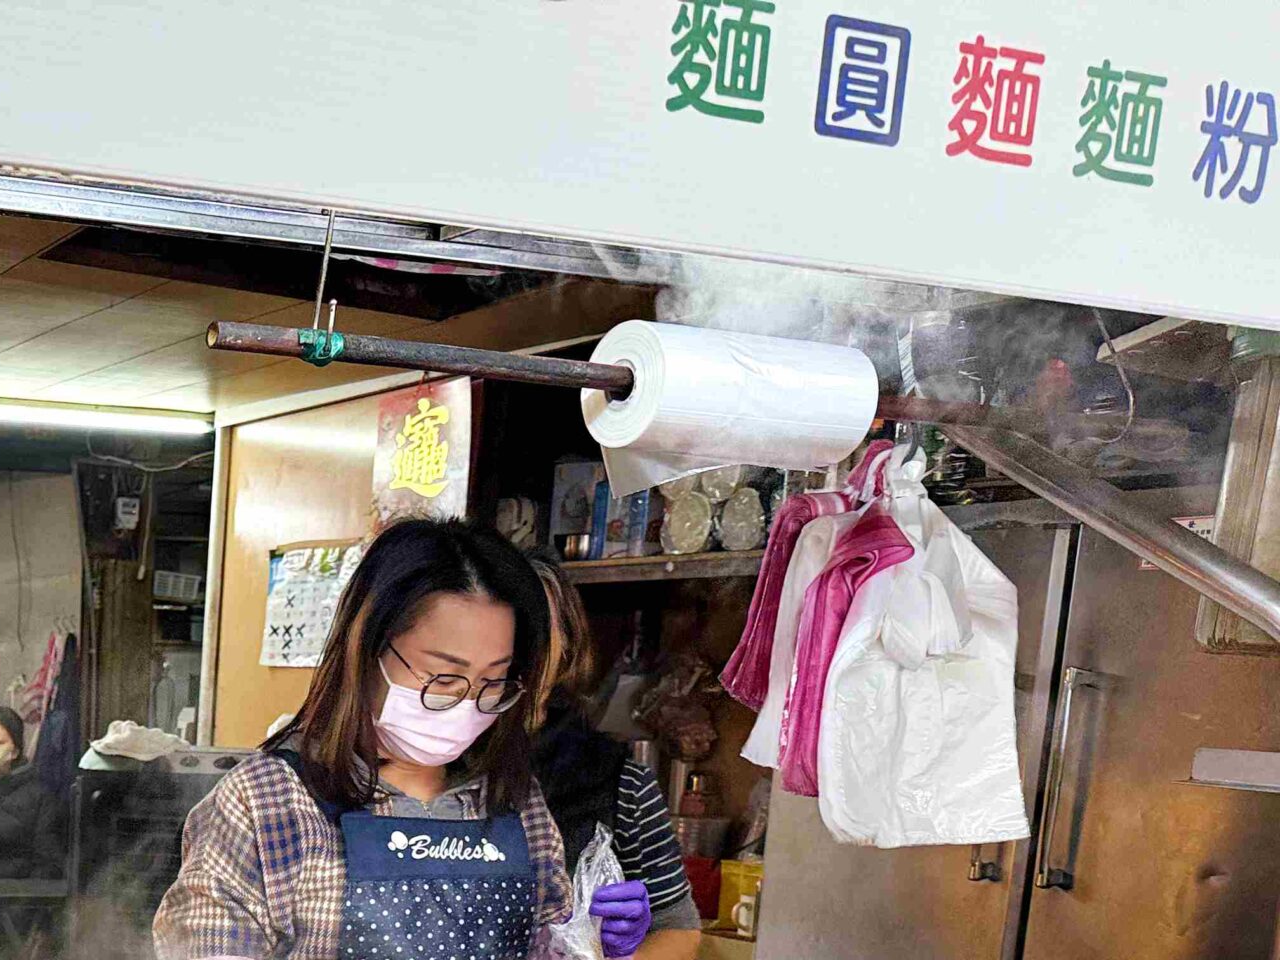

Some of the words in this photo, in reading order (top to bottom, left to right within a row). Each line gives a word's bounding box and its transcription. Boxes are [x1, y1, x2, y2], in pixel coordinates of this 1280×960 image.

[665, 0, 776, 124] 麵
[814, 13, 912, 147] 圓
[945, 34, 1046, 168] 麵
[1072, 58, 1168, 187] 麵
[1192, 80, 1278, 205] 粉
[408, 834, 485, 861] Bubbles
